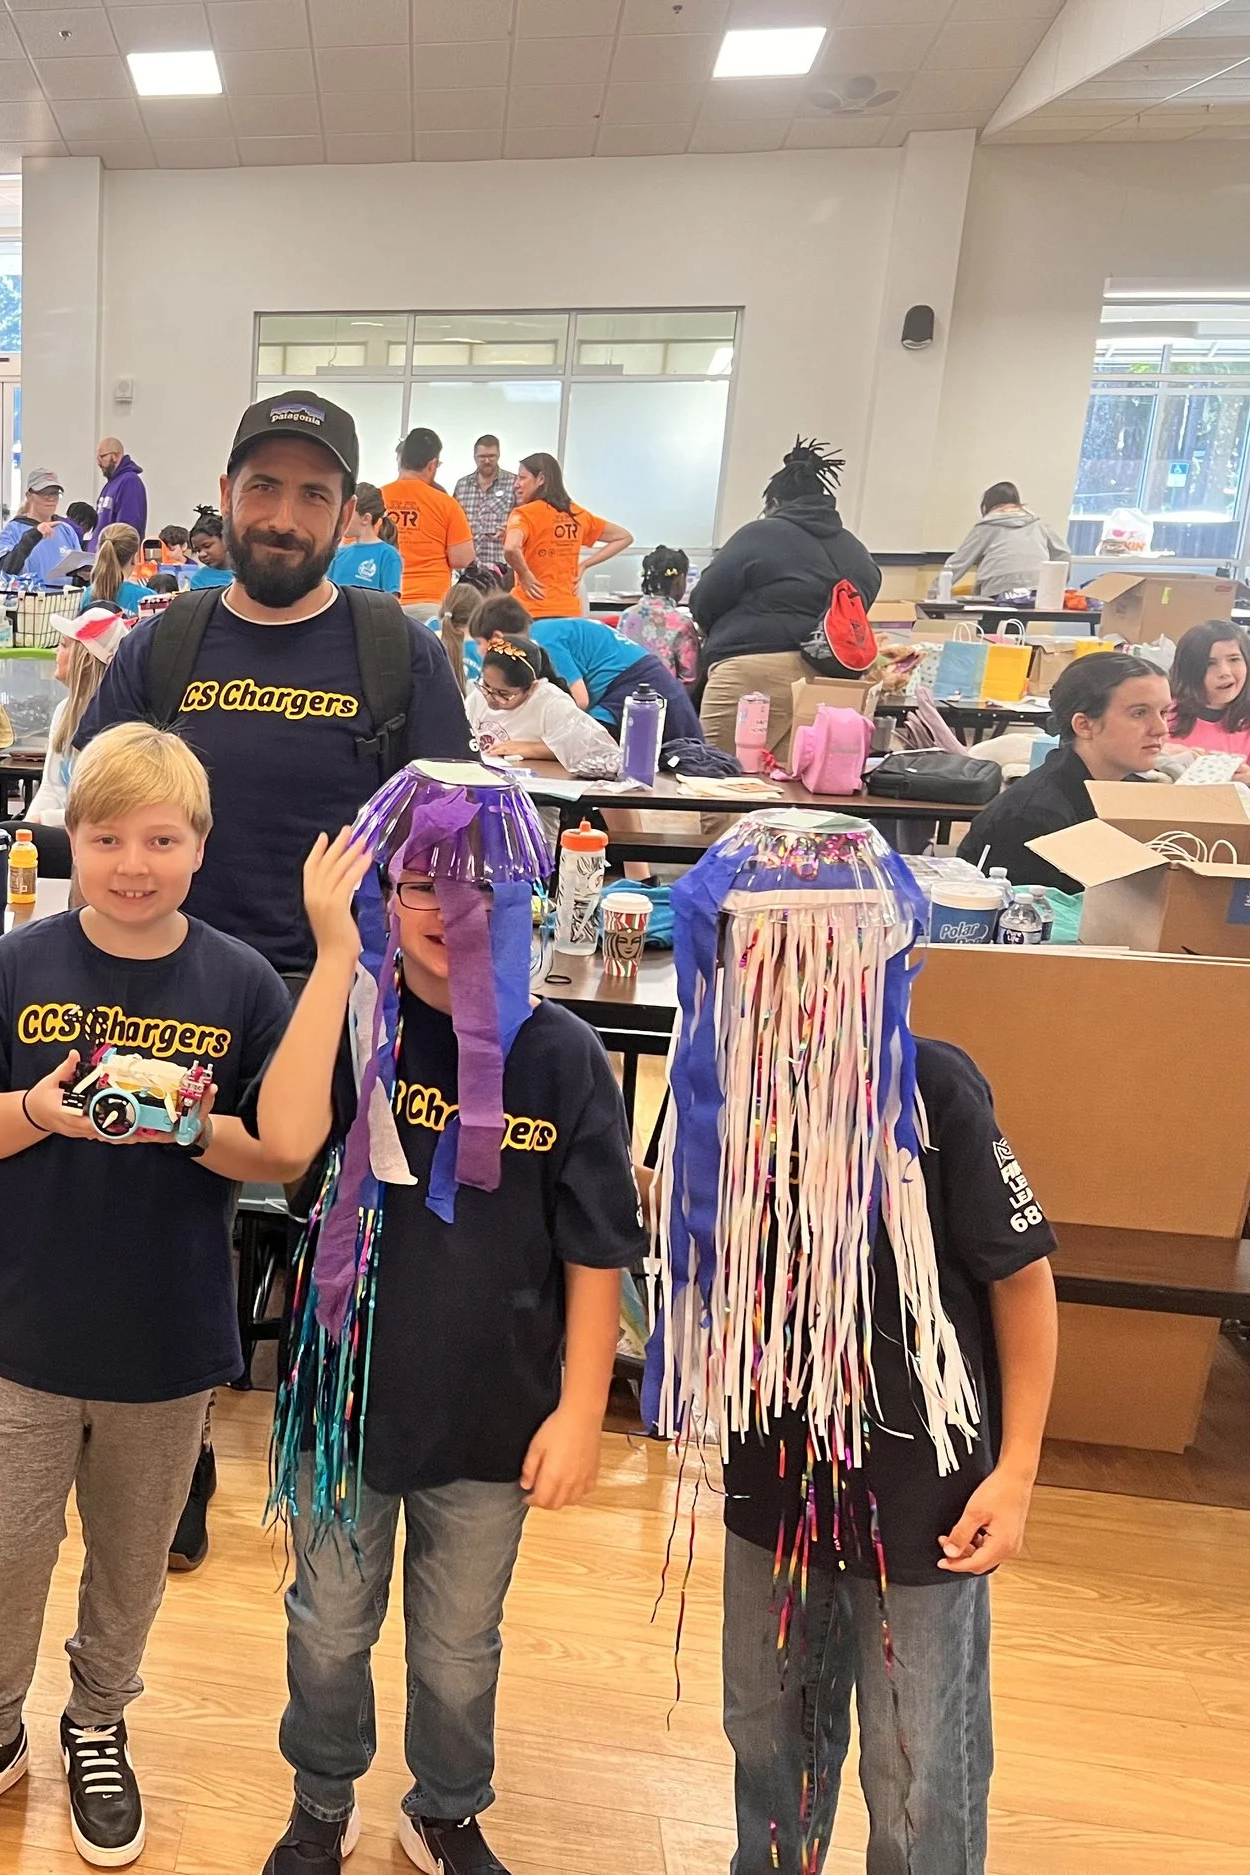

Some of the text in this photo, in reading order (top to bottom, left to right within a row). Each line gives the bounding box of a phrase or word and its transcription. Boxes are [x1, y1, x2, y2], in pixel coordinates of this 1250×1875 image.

[271, 413, 321, 426] patagonia
[554, 524, 578, 539] OTR
[179, 678, 358, 720] CS Chargers
[940, 921, 980, 940] Polar
[18, 1003, 231, 1058] CCS Chargers
[1010, 1202, 1043, 1233] 68
